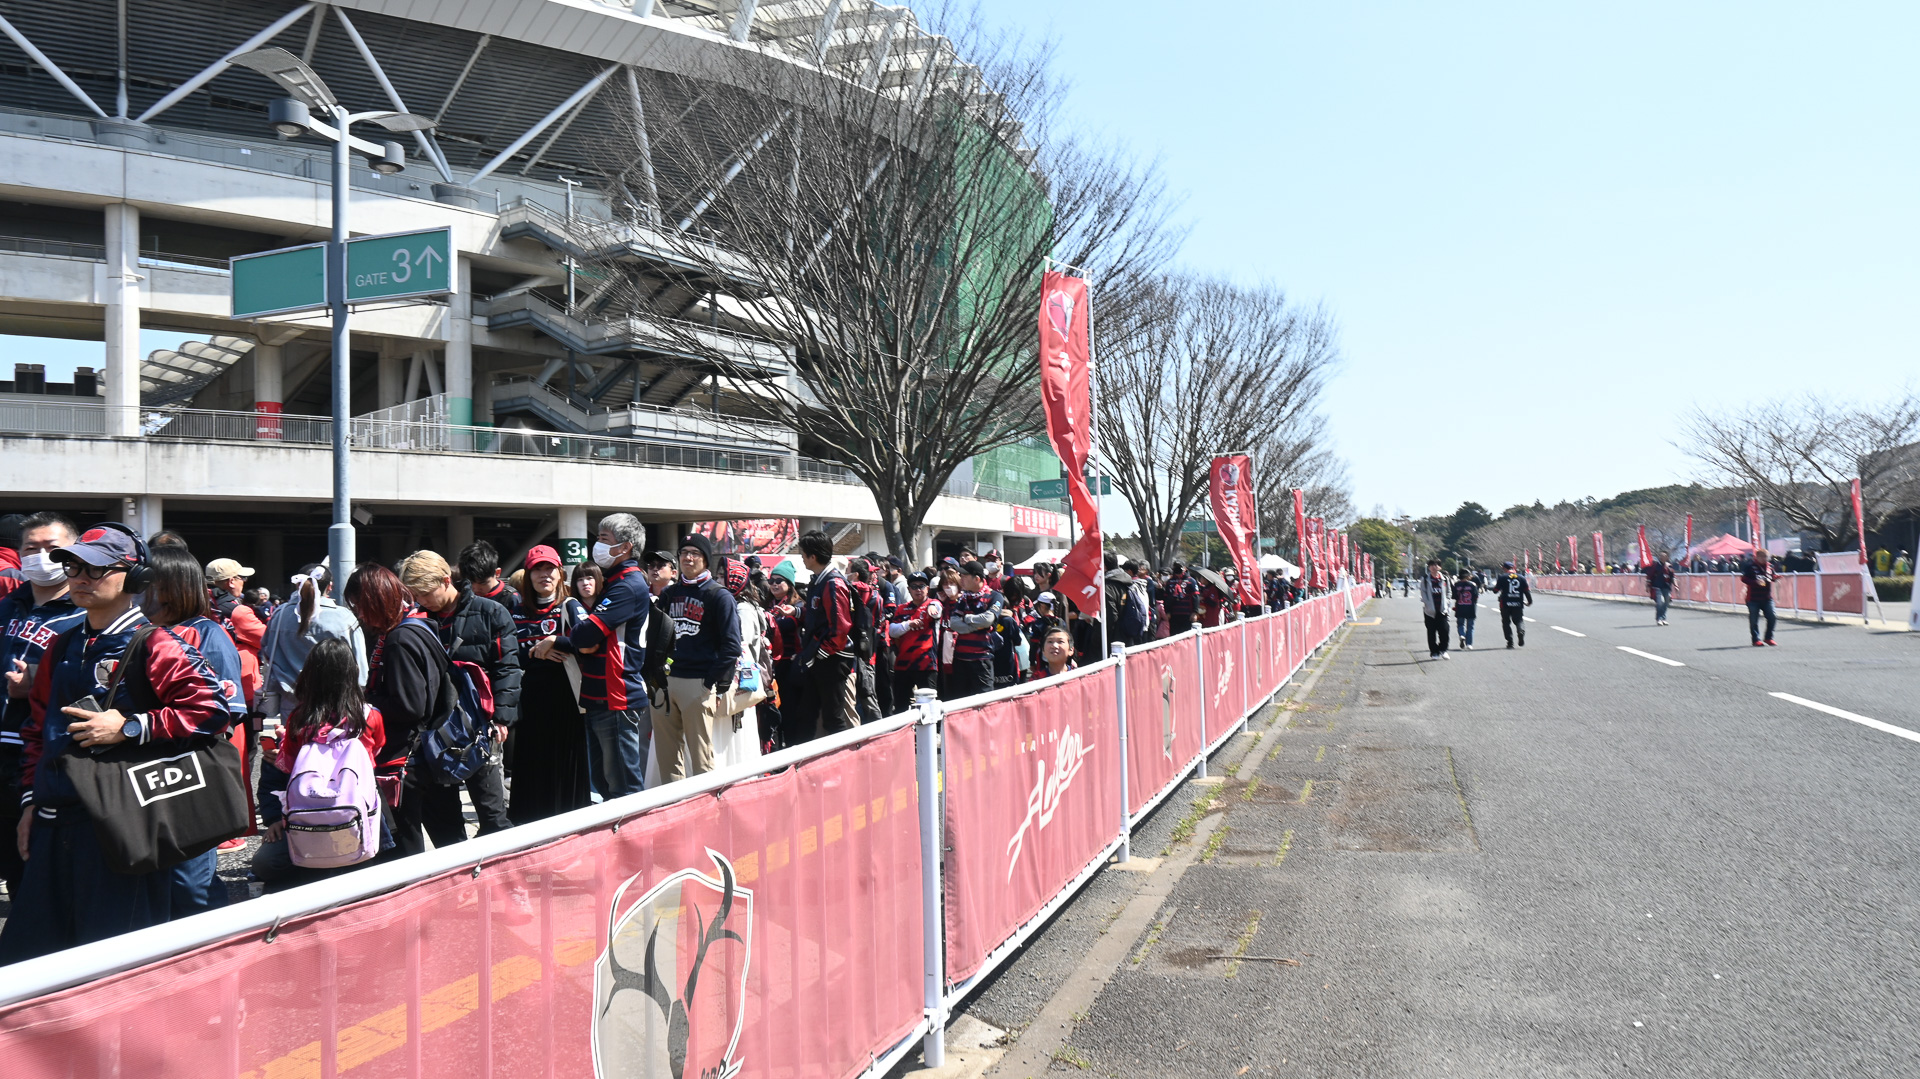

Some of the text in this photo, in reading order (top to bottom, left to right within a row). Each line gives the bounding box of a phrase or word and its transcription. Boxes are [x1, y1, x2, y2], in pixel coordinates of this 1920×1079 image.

[355, 248, 412, 287] GATE 3
[1055, 482, 1064, 495] 3
[567, 541, 581, 556] 3
[1507, 578, 1521, 594] 12
[1457, 591, 1473, 605] 12
[145, 767, 193, 790] F.D.
